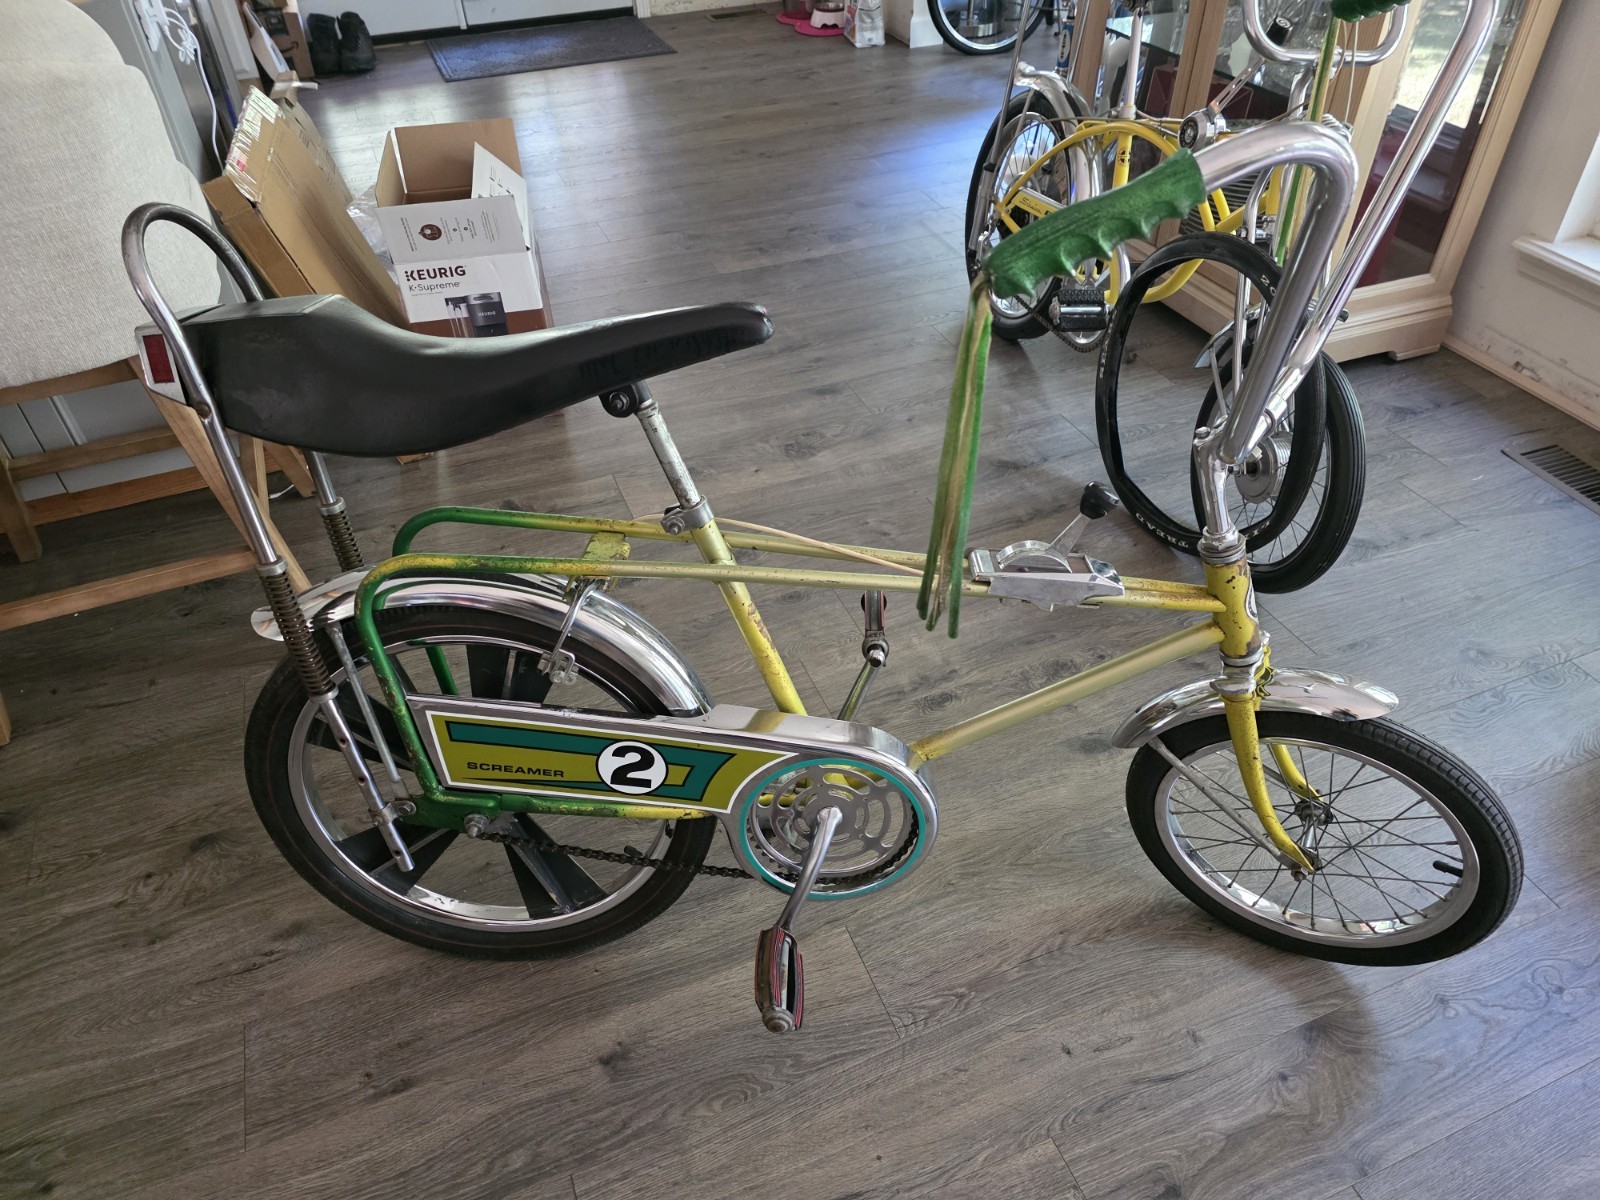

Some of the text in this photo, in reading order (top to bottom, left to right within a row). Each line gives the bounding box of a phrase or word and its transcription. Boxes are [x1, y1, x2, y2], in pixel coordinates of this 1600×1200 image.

[404, 265, 467, 282] KEURIG
[1135, 513, 1189, 548] TREAD
[466, 745, 656, 789] SCREAMER 2
